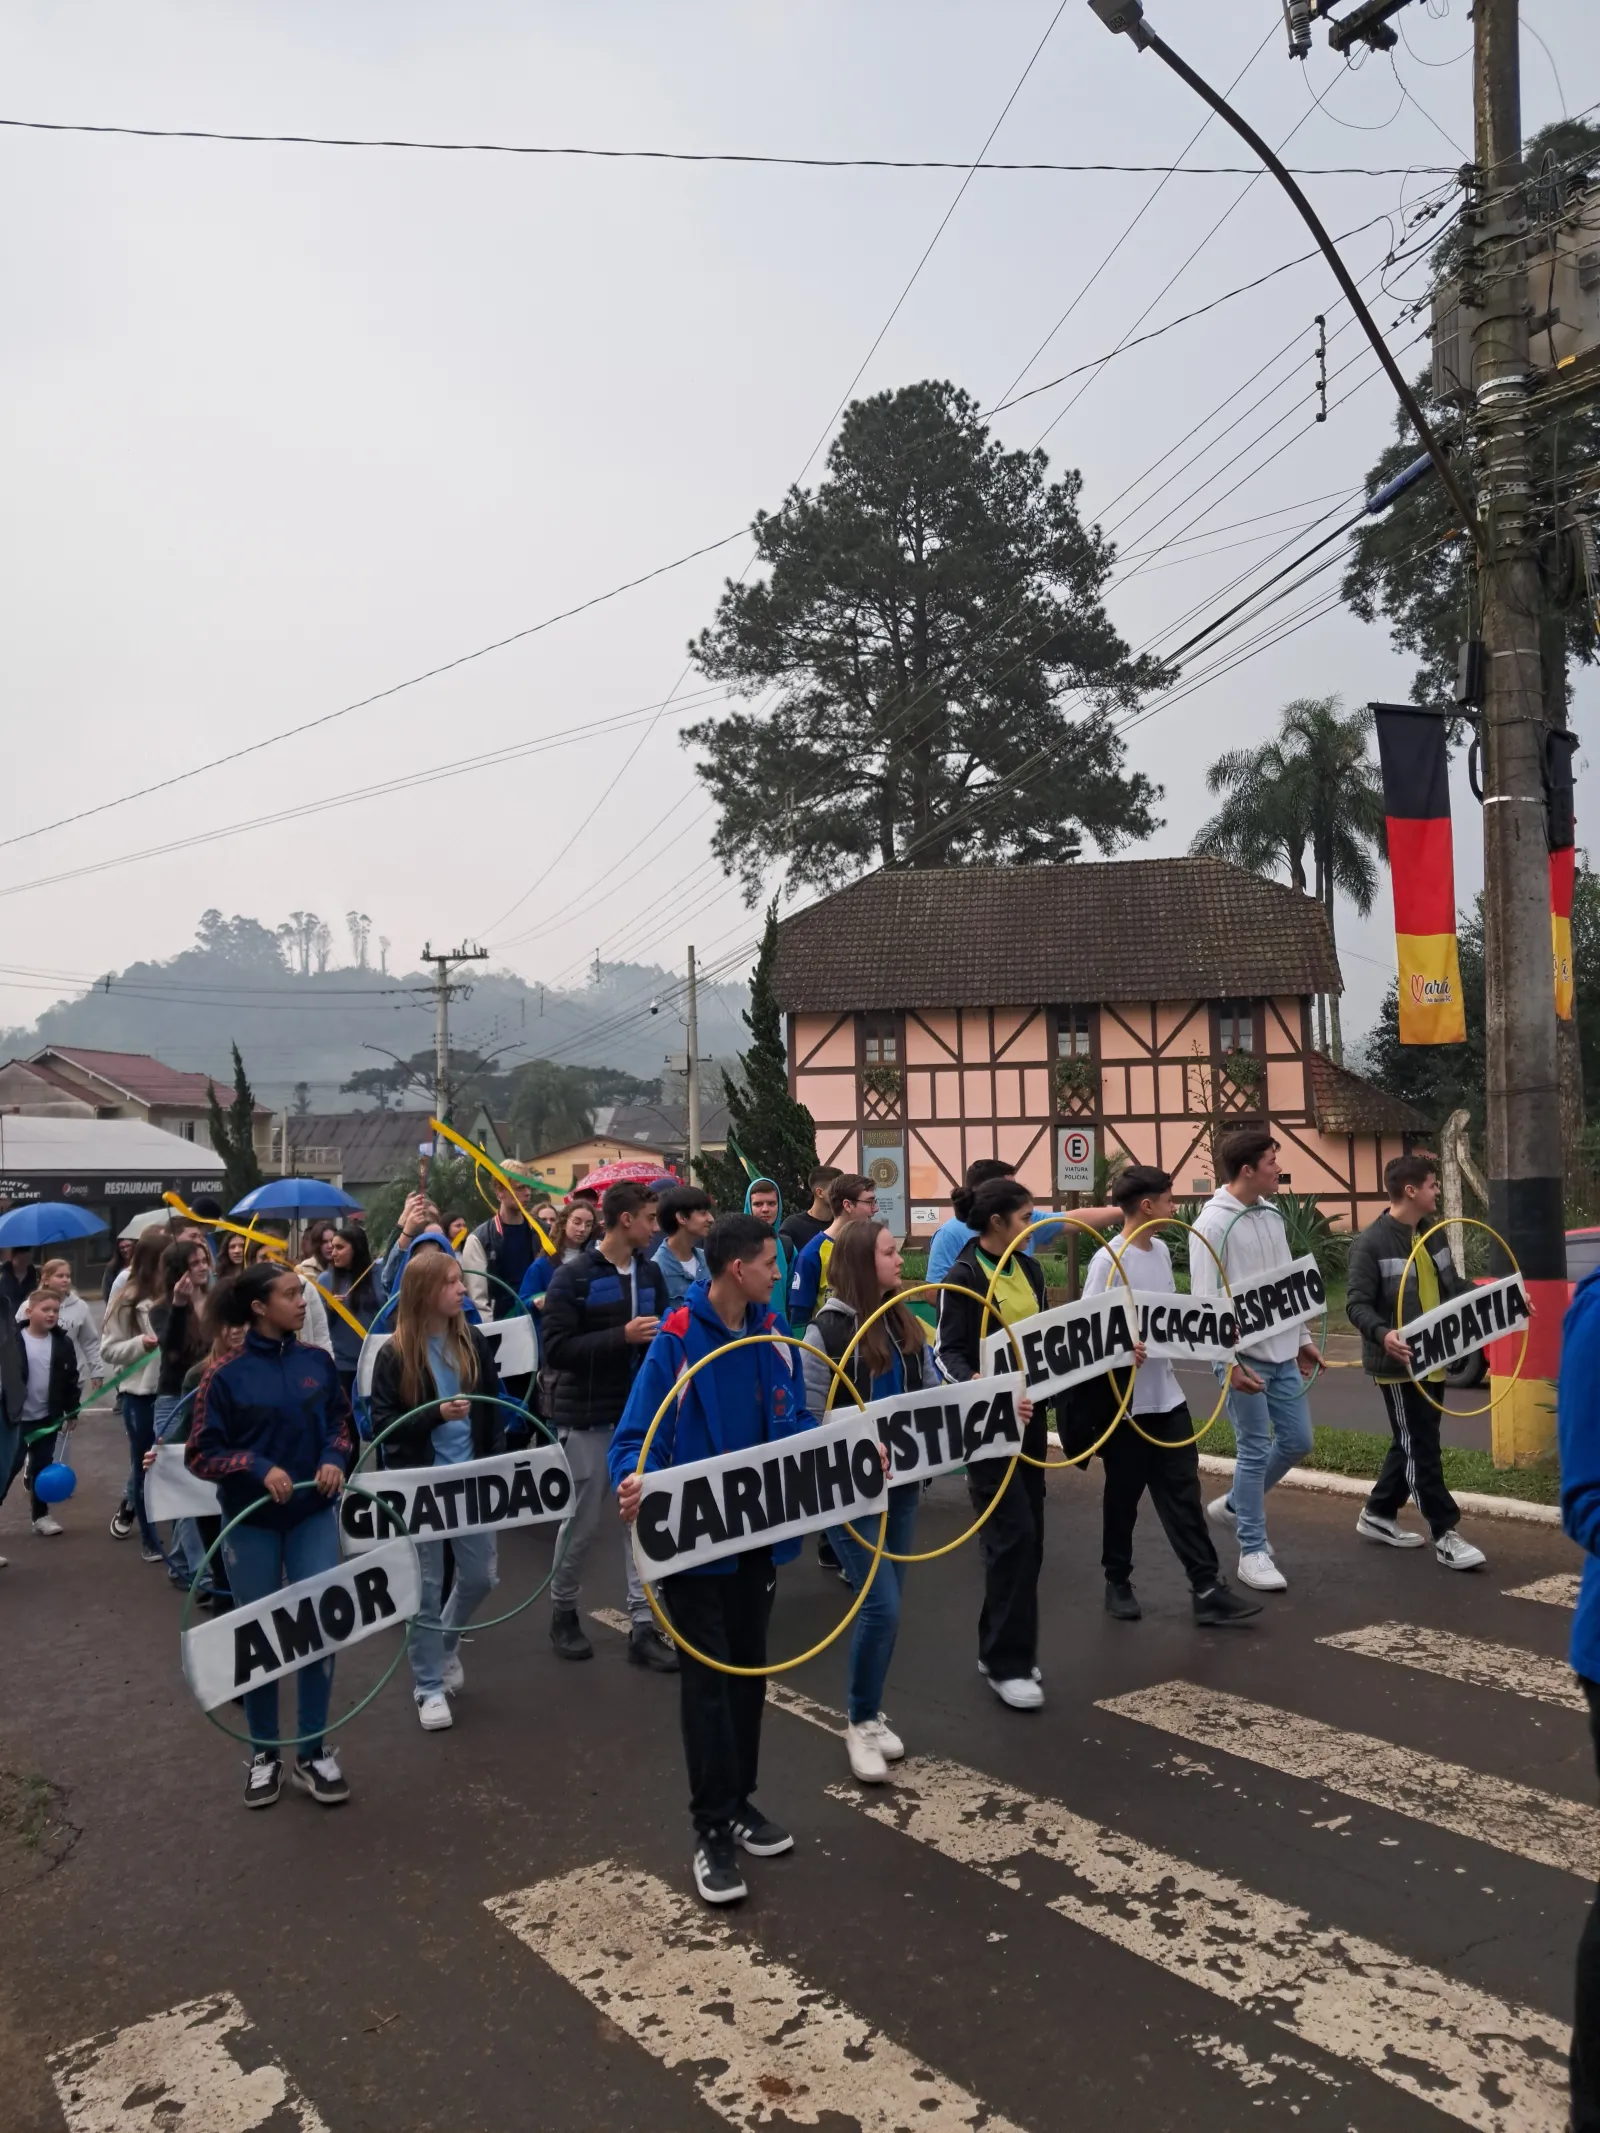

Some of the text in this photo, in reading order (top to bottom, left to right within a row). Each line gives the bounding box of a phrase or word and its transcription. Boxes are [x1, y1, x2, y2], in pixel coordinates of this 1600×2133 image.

[0, 1180, 30, 1190] ANTE
[1072, 1139, 1082, 1157] E
[104, 1181, 163, 1195] RESTAURANTE
[1233, 1269, 1326, 1339] ESPEITO
[1406, 1283, 1530, 1376] EMPATIA
[341, 1461, 571, 1540] GRATIDÃO
[636, 1438, 884, 1562] CARINHO
[234, 1566, 397, 1688] AMOR
